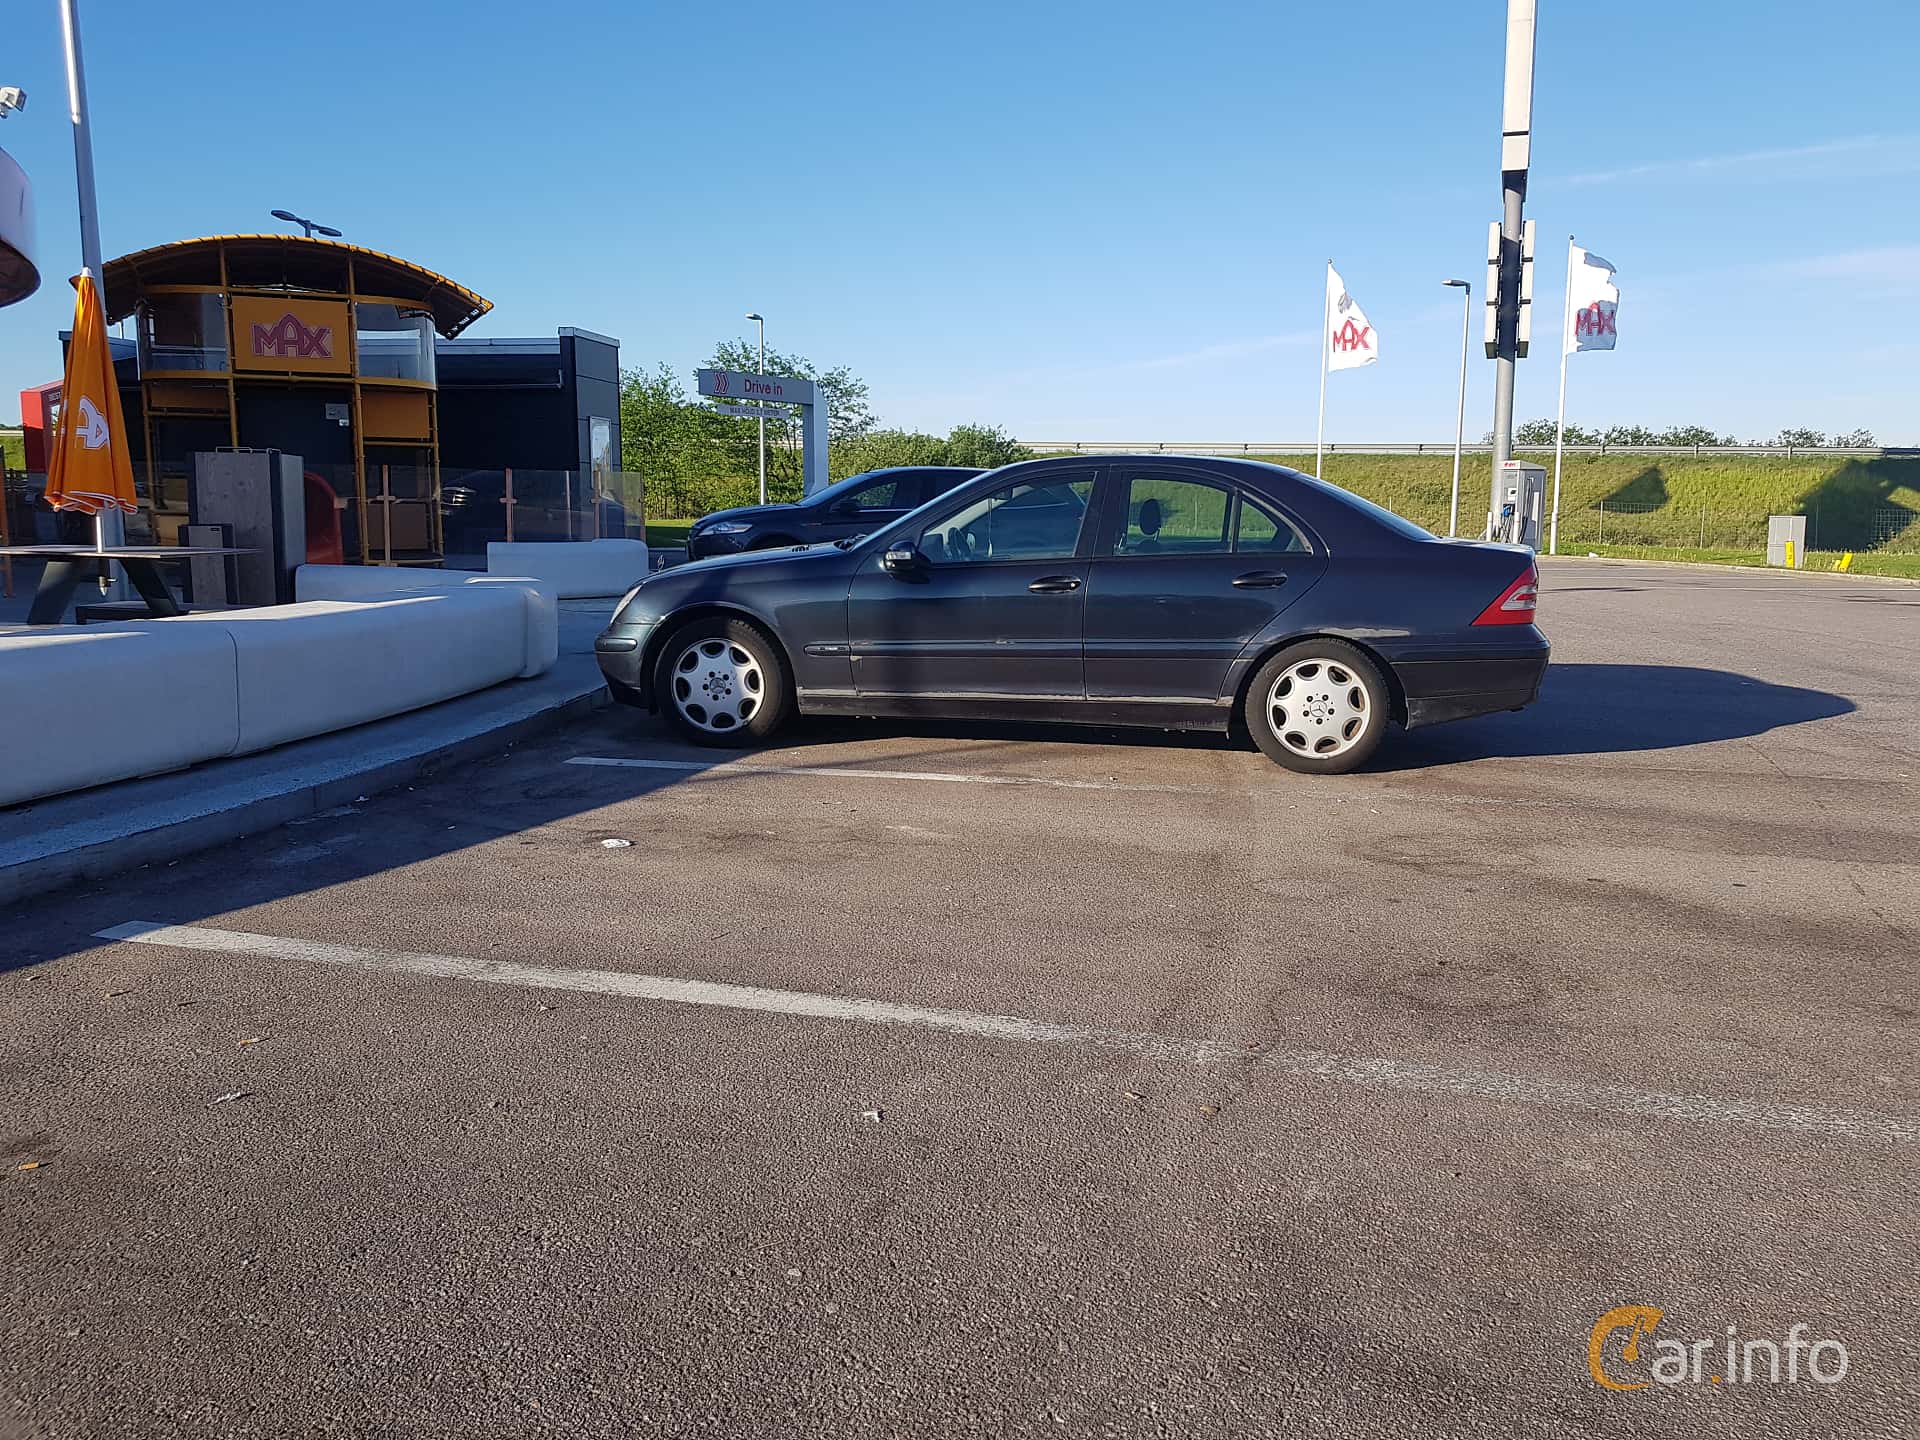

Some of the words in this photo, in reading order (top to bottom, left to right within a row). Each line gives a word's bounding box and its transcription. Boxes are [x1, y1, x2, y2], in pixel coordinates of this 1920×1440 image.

[252, 312, 333, 358] MAX
[1333, 319, 1370, 352] MAX
[1575, 302, 1616, 336] MAX
[744, 379, 772, 394] Drive
[773, 382, 783, 395] in
